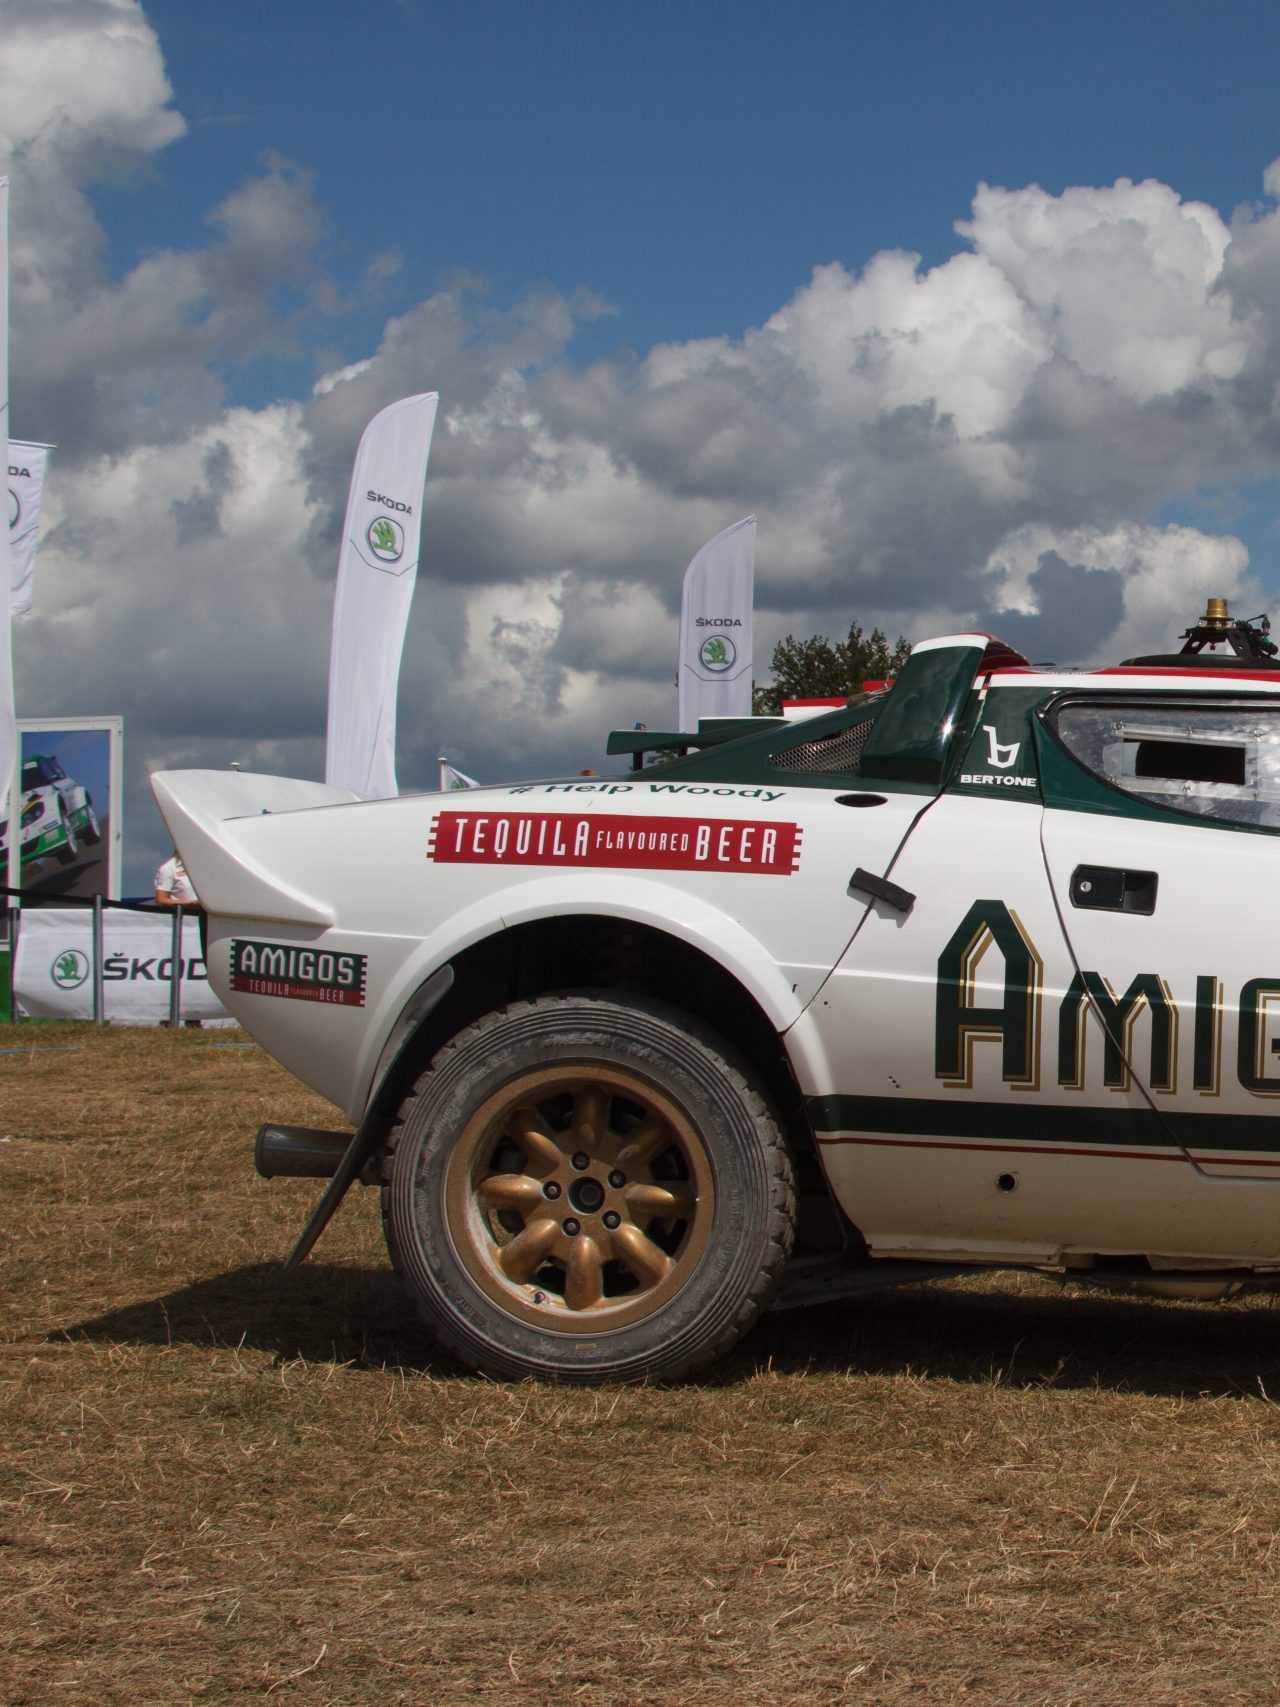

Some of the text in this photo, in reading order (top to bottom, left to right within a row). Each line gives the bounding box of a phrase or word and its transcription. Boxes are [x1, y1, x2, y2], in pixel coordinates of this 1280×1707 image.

[366, 490, 412, 516] ŠKODA
[695, 617, 742, 627] ŠKODA
[545, 784, 634, 795] Help
[649, 784, 787, 801] Woody
[960, 774, 1037, 787] BERTONE
[455, 818, 777, 864] TEQUILA FLAVOURED BEER
[103, 953, 207, 981] ŠKOD
[240, 945, 354, 985] AMIGOS
[250, 979, 290, 996] TEQUILA
[319, 988, 345, 1003] BEER
